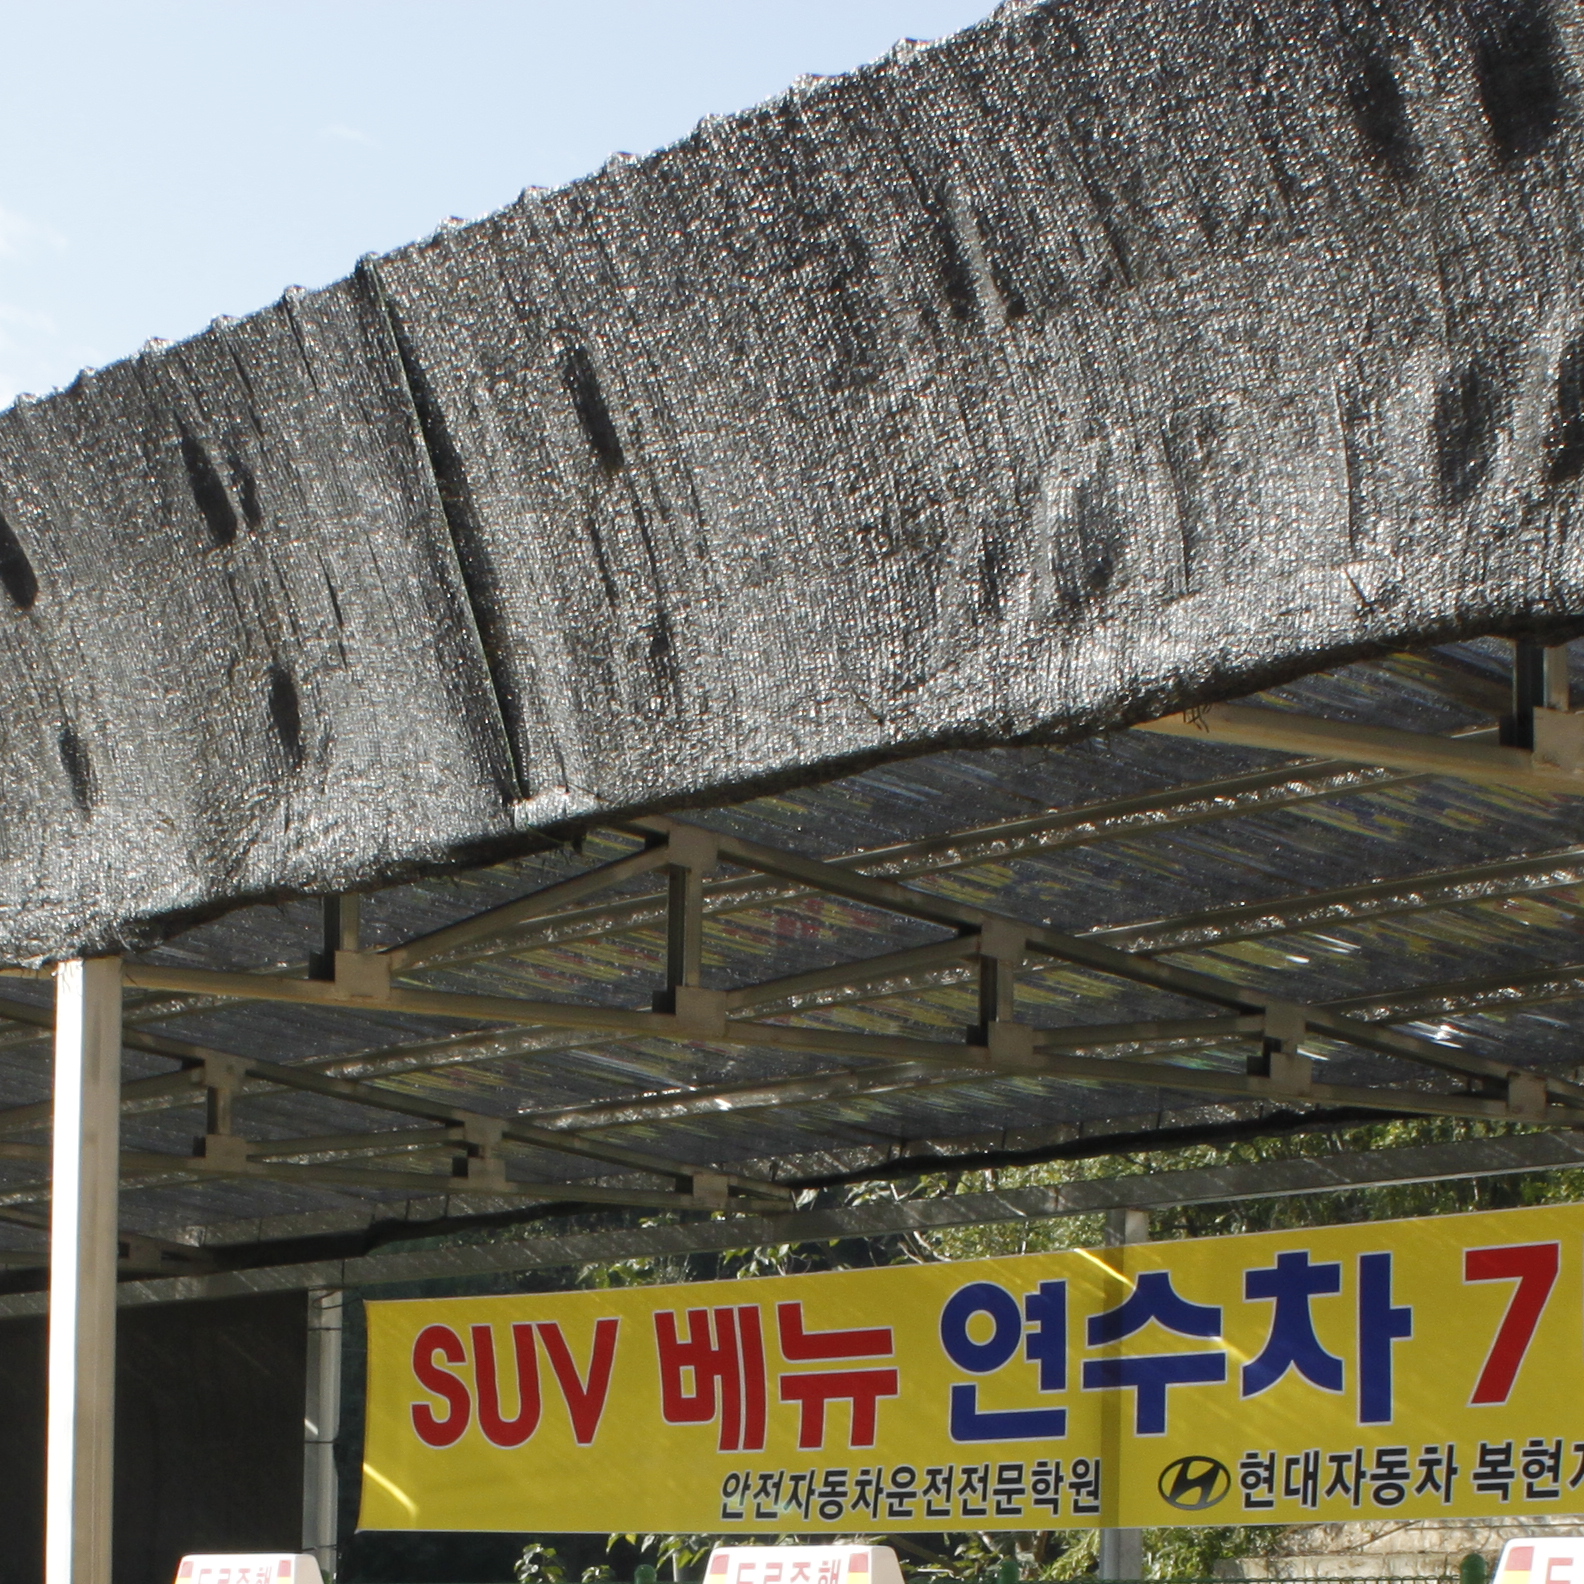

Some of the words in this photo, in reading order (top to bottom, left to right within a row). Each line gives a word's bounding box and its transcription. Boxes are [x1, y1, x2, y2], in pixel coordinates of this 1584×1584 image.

[411, 1317, 620, 1449] SUV
[654, 1301, 899, 1453] 베뉴
[940, 1250, 1413, 1443] 연수차
[720, 1458, 1101, 1522] 안전자동차운전전문학원
[1239, 1443, 1458, 1510] 현대자동차
